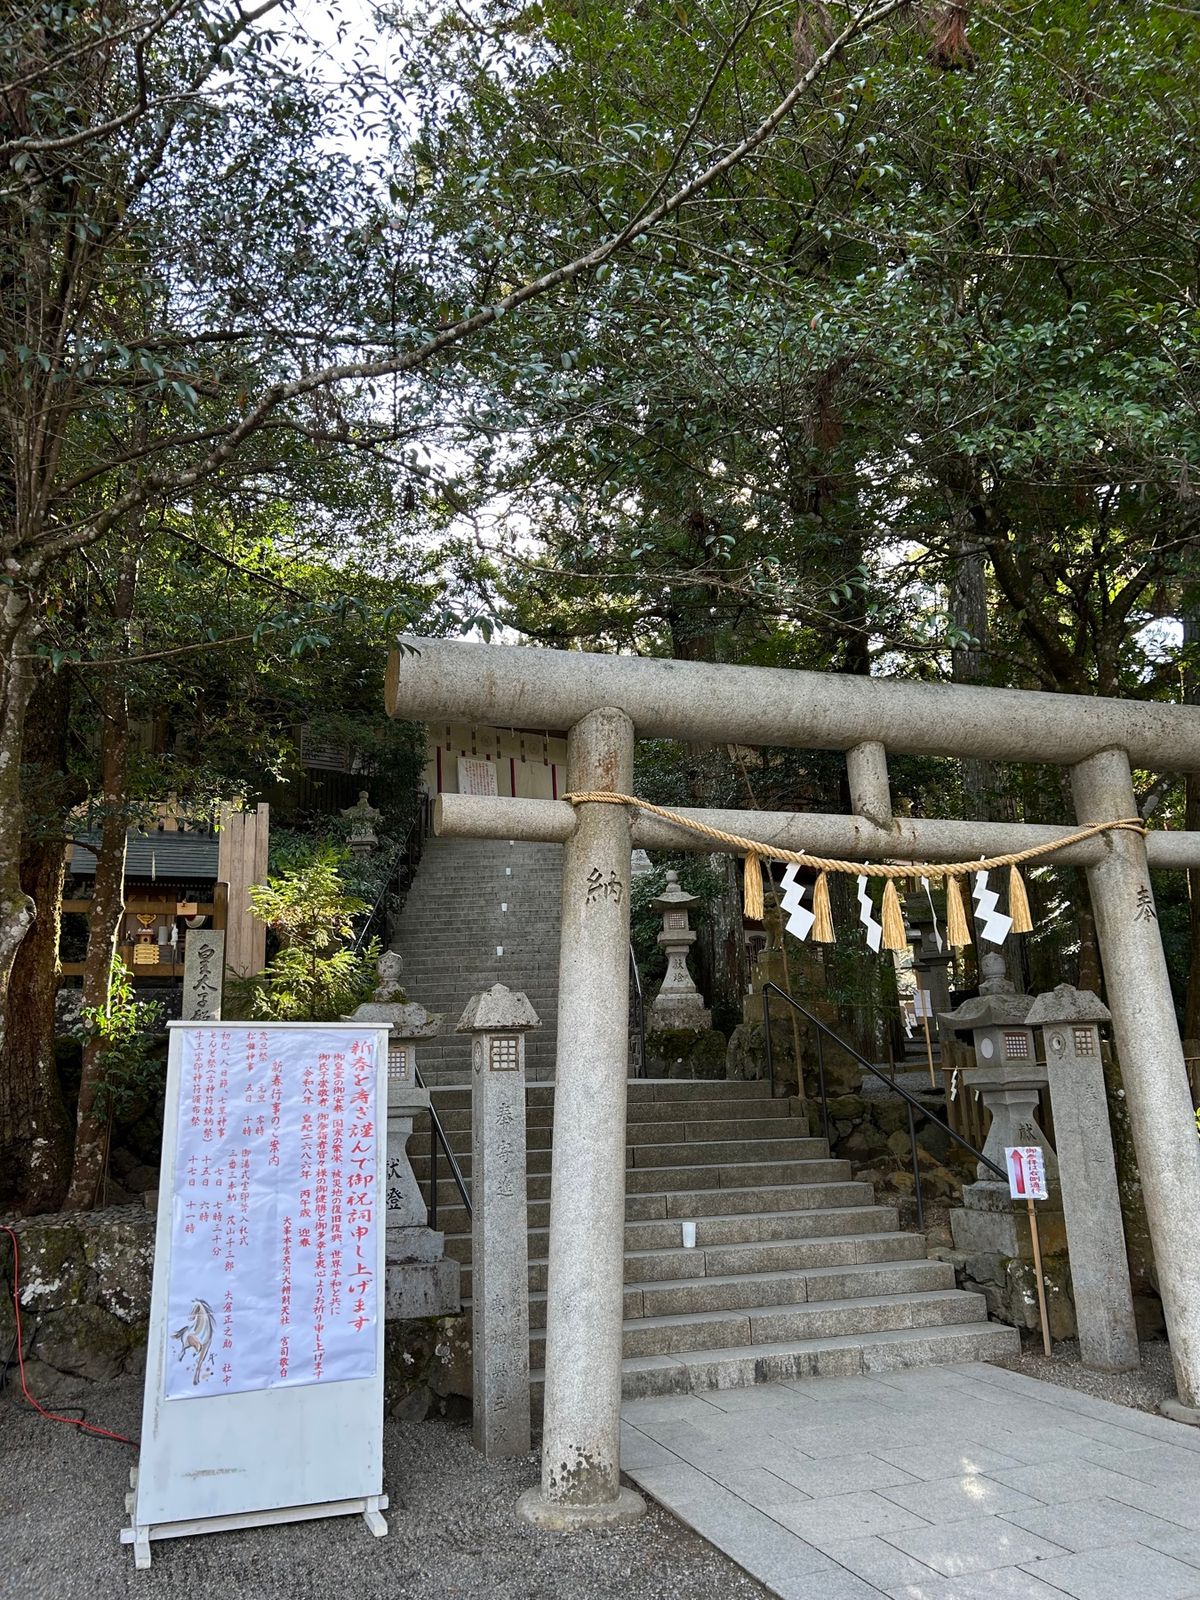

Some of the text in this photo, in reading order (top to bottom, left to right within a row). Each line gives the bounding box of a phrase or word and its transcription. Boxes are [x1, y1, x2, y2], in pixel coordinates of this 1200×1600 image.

[585, 867, 623, 906] 納
[1133, 885, 1157, 923] 奉
[268, 1060, 284, 1167] 新春行事のご案内
[187, 1155, 199, 1187] 十七日
[201, 1155, 212, 1187] 十五日
